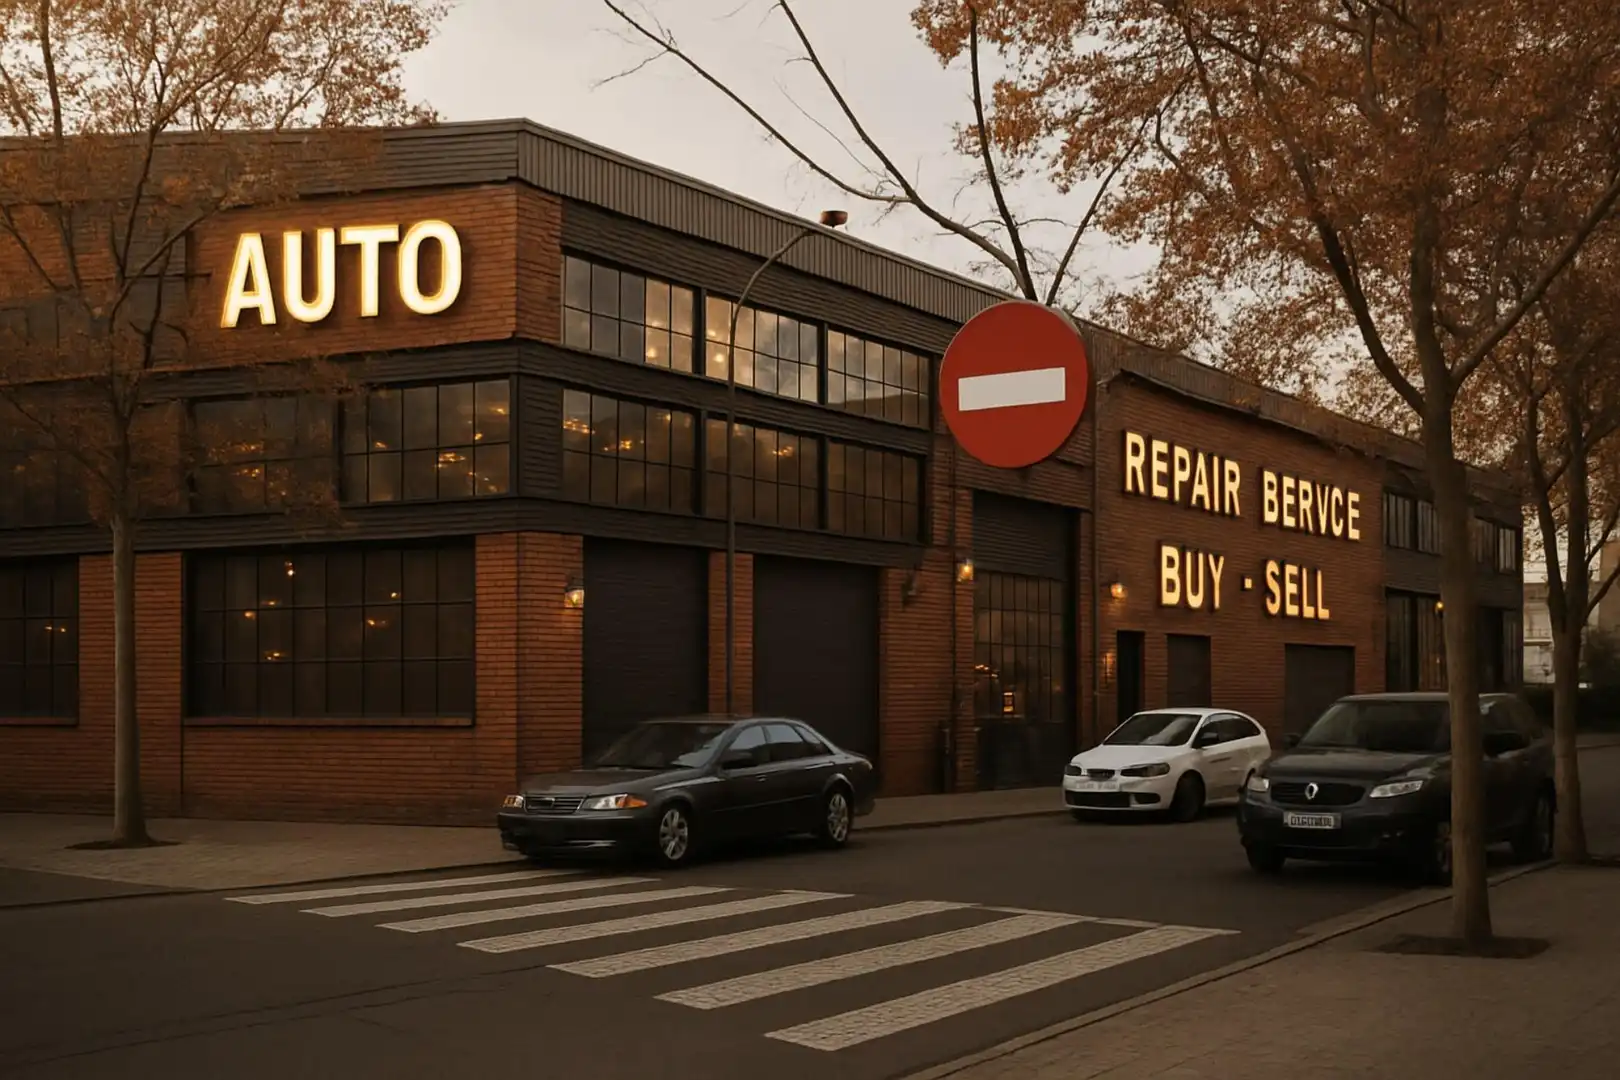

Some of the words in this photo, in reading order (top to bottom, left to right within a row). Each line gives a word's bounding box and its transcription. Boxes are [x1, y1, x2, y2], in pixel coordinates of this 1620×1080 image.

[219, 218, 463, 329] AUTO
[1124, 431, 1242, 516] REPAIR
[1262, 469, 1361, 541] BERVCE
[1160, 544, 1225, 609] BUY
[1265, 559, 1331, 620] SELL
